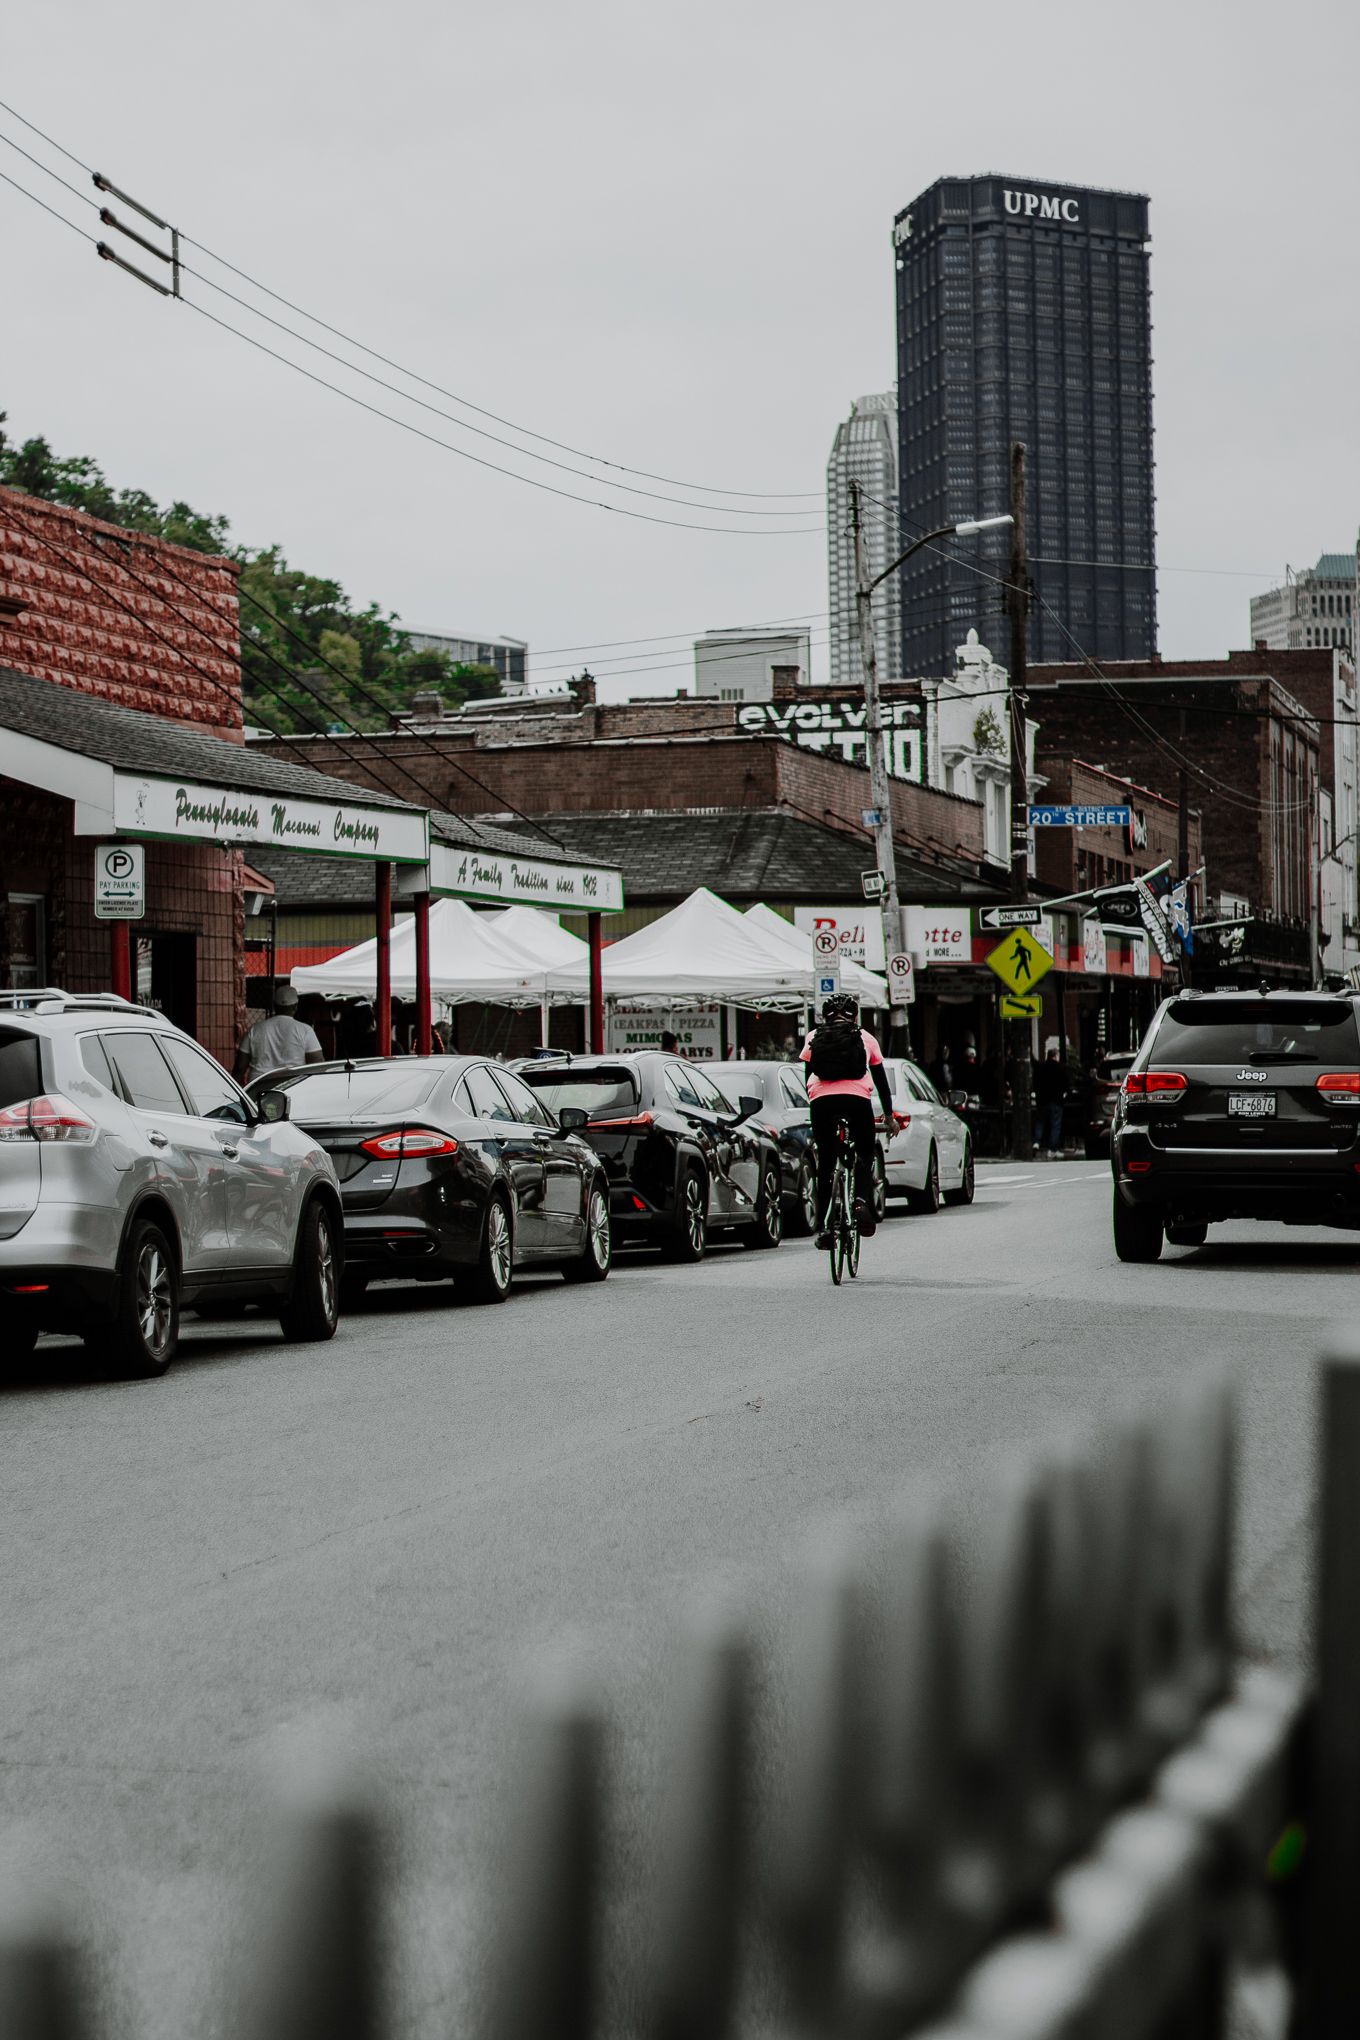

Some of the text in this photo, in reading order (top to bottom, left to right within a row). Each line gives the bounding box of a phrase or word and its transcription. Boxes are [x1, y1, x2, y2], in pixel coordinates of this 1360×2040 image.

[1003, 189, 1079, 222] UPMC
[175, 788, 378, 850] Pennsylvania Macaroni Company
[1065, 812, 1126, 825] STREET
[457, 856, 467, 884] A
[471, 857, 502, 891] Family
[99, 881, 140, 889] PAY PARKING
[999, 911, 1034, 921] ONE WAY
[679, 1018, 715, 1030] PIZZA
[681, 1047, 713, 1058] ARYS
[1236, 1069, 1268, 1083] Jeep
